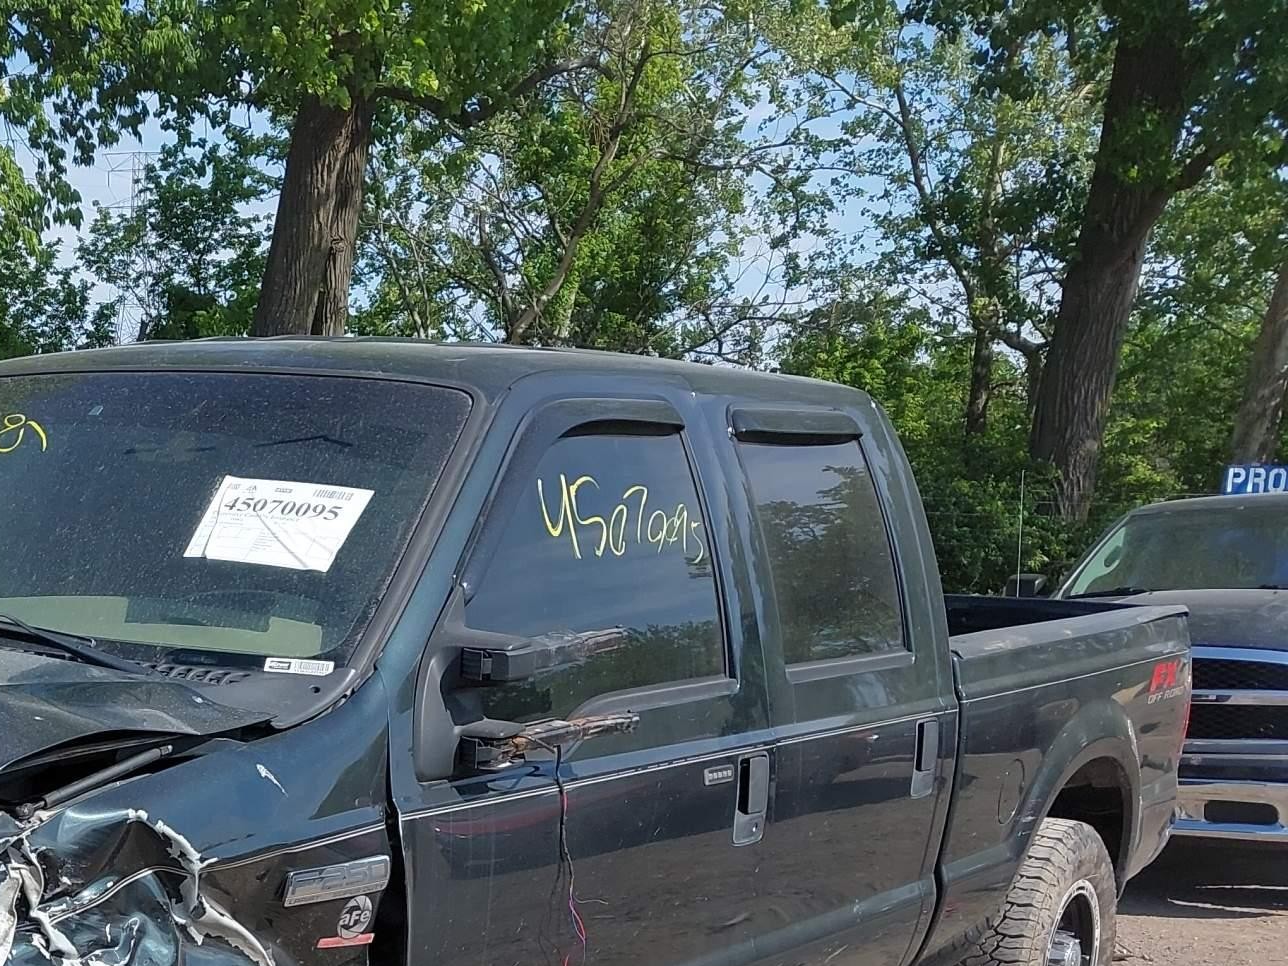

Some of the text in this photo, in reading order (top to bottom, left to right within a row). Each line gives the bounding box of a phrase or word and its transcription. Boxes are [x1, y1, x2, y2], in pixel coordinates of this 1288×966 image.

[1226, 467, 1288, 493] PRO
[224, 496, 344, 521] 45070095
[340, 909, 371, 926] aFe
